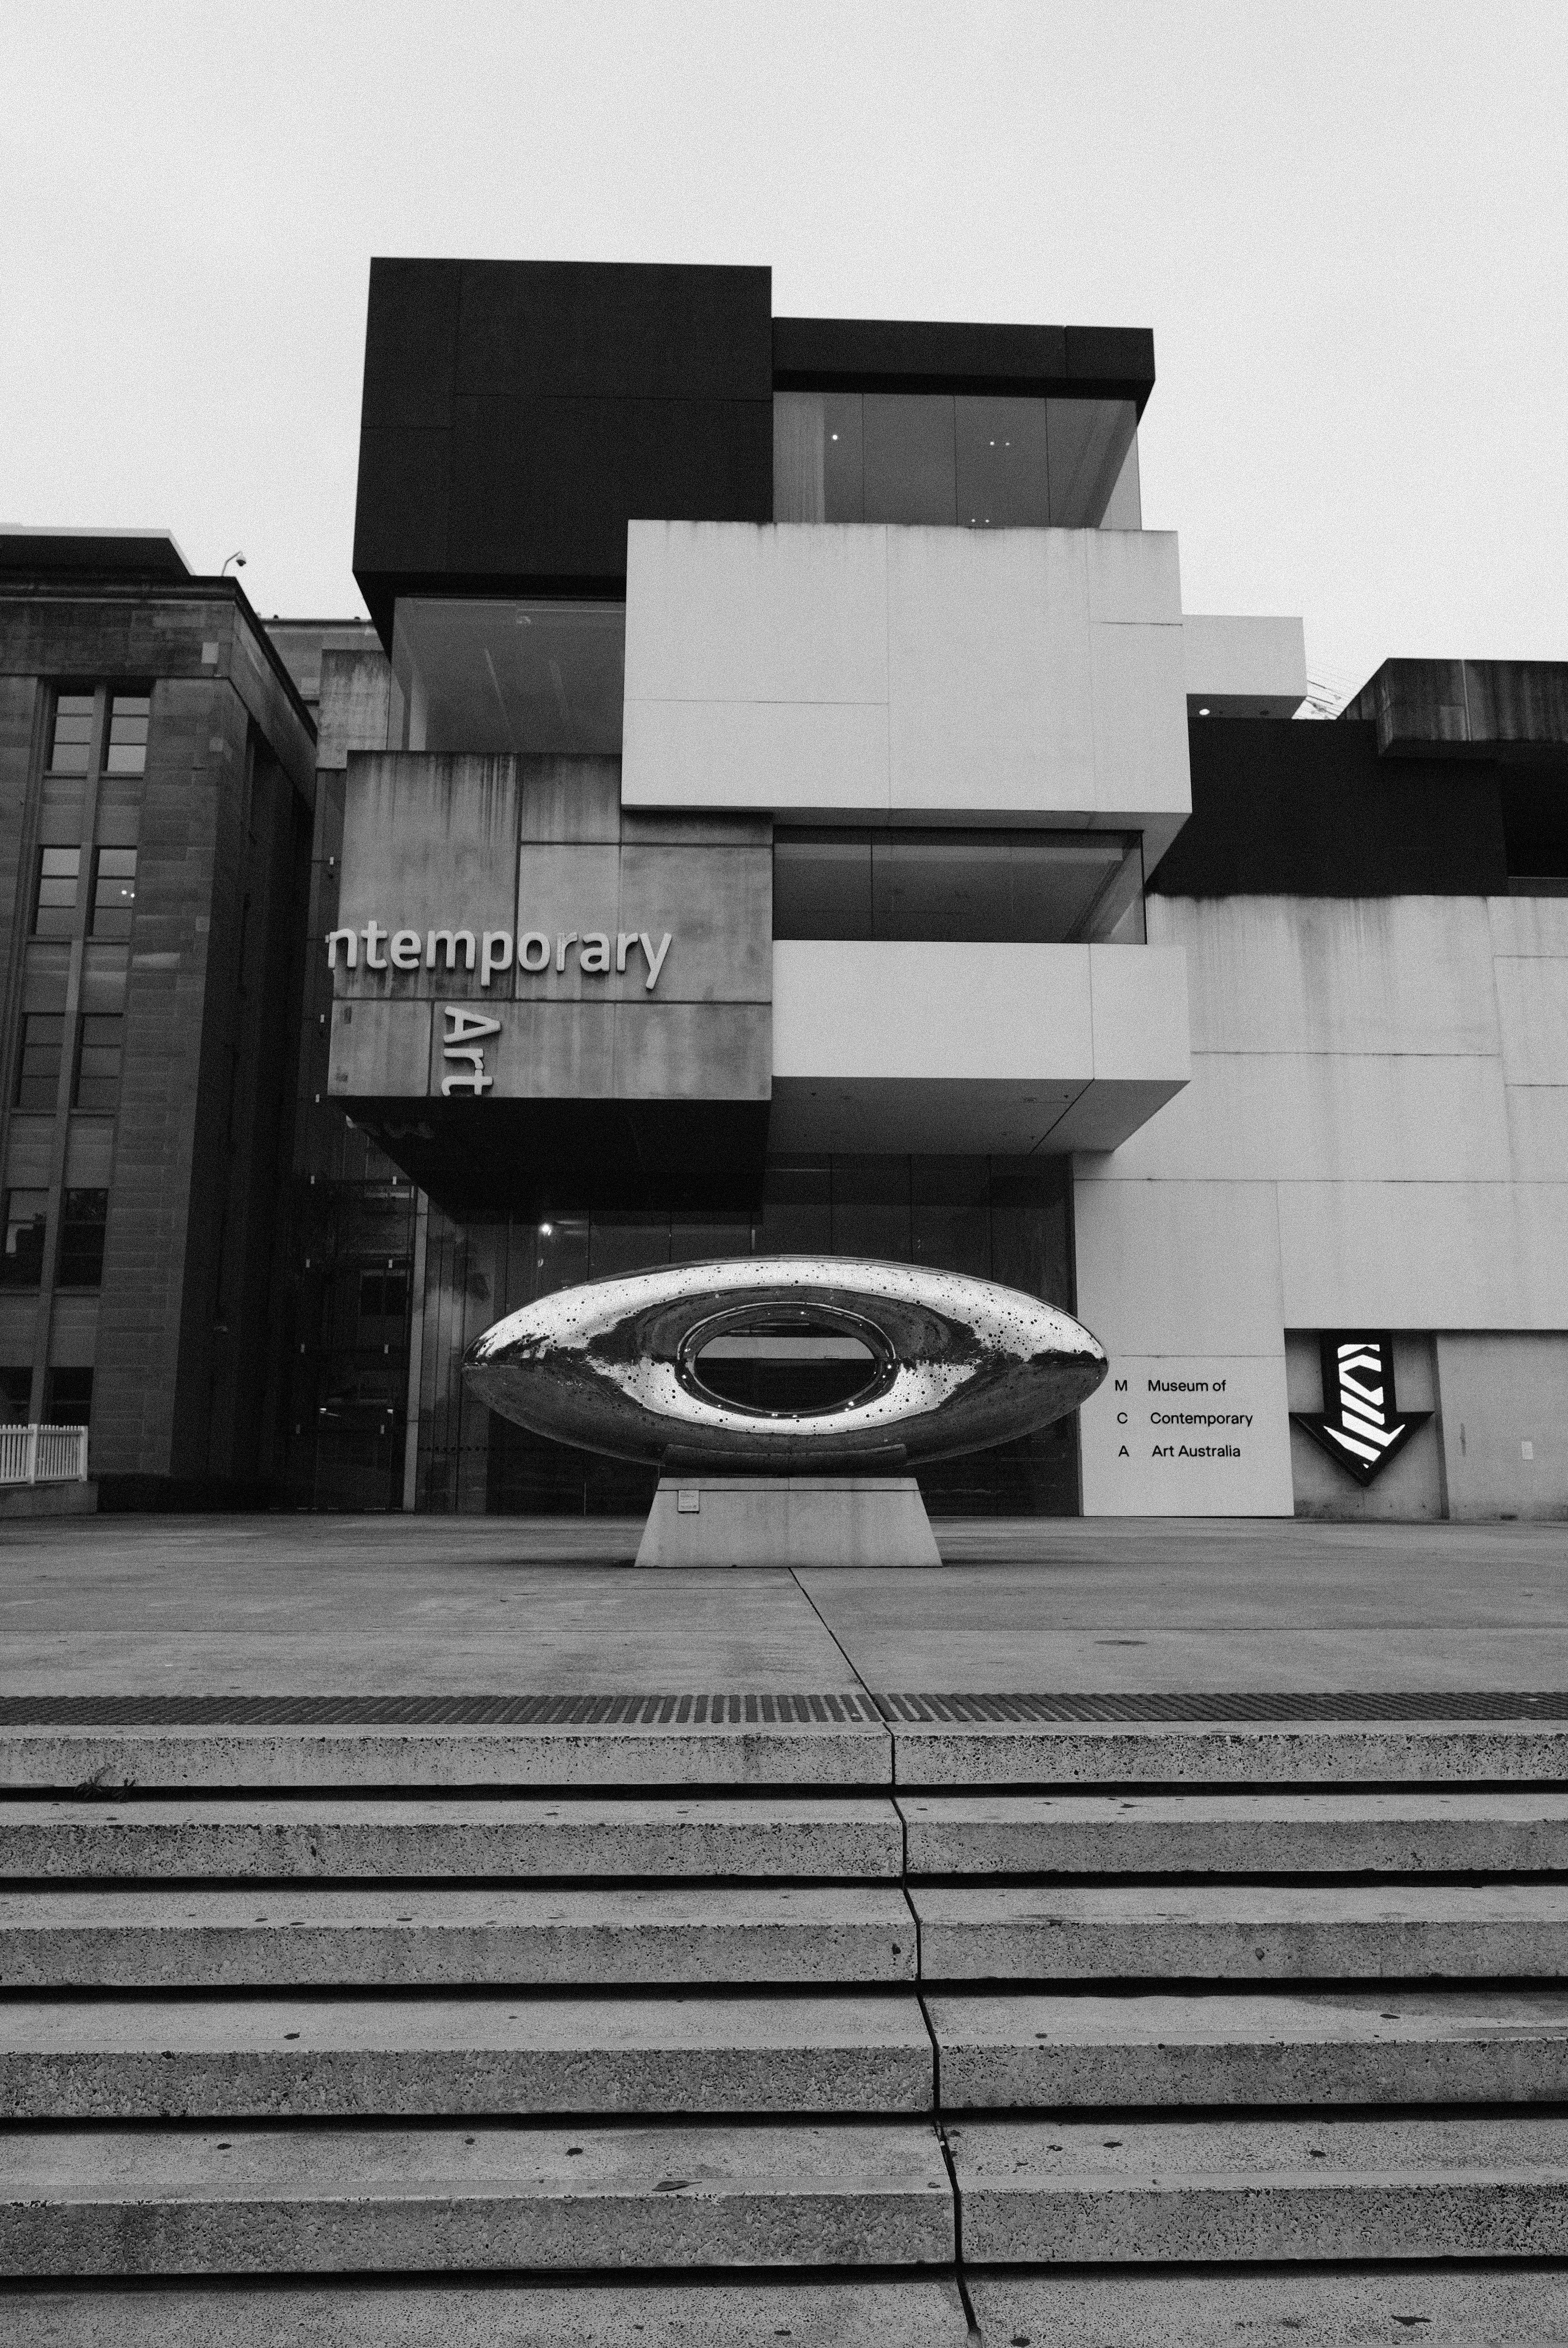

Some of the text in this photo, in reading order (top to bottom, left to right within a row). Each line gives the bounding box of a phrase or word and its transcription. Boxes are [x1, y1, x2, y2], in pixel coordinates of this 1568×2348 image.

[328, 920, 672, 990] ntemporary
[441, 1006, 501, 1096] Art
[1115, 1379, 1128, 1392] M
[1148, 1379, 1226, 1392] Museum of
[1117, 1412, 1128, 1424] C
[1150, 1412, 1253, 1427] Contemporary
[1118, 1445, 1129, 1457] A
[1152, 1445, 1241, 1458] Art Australia
